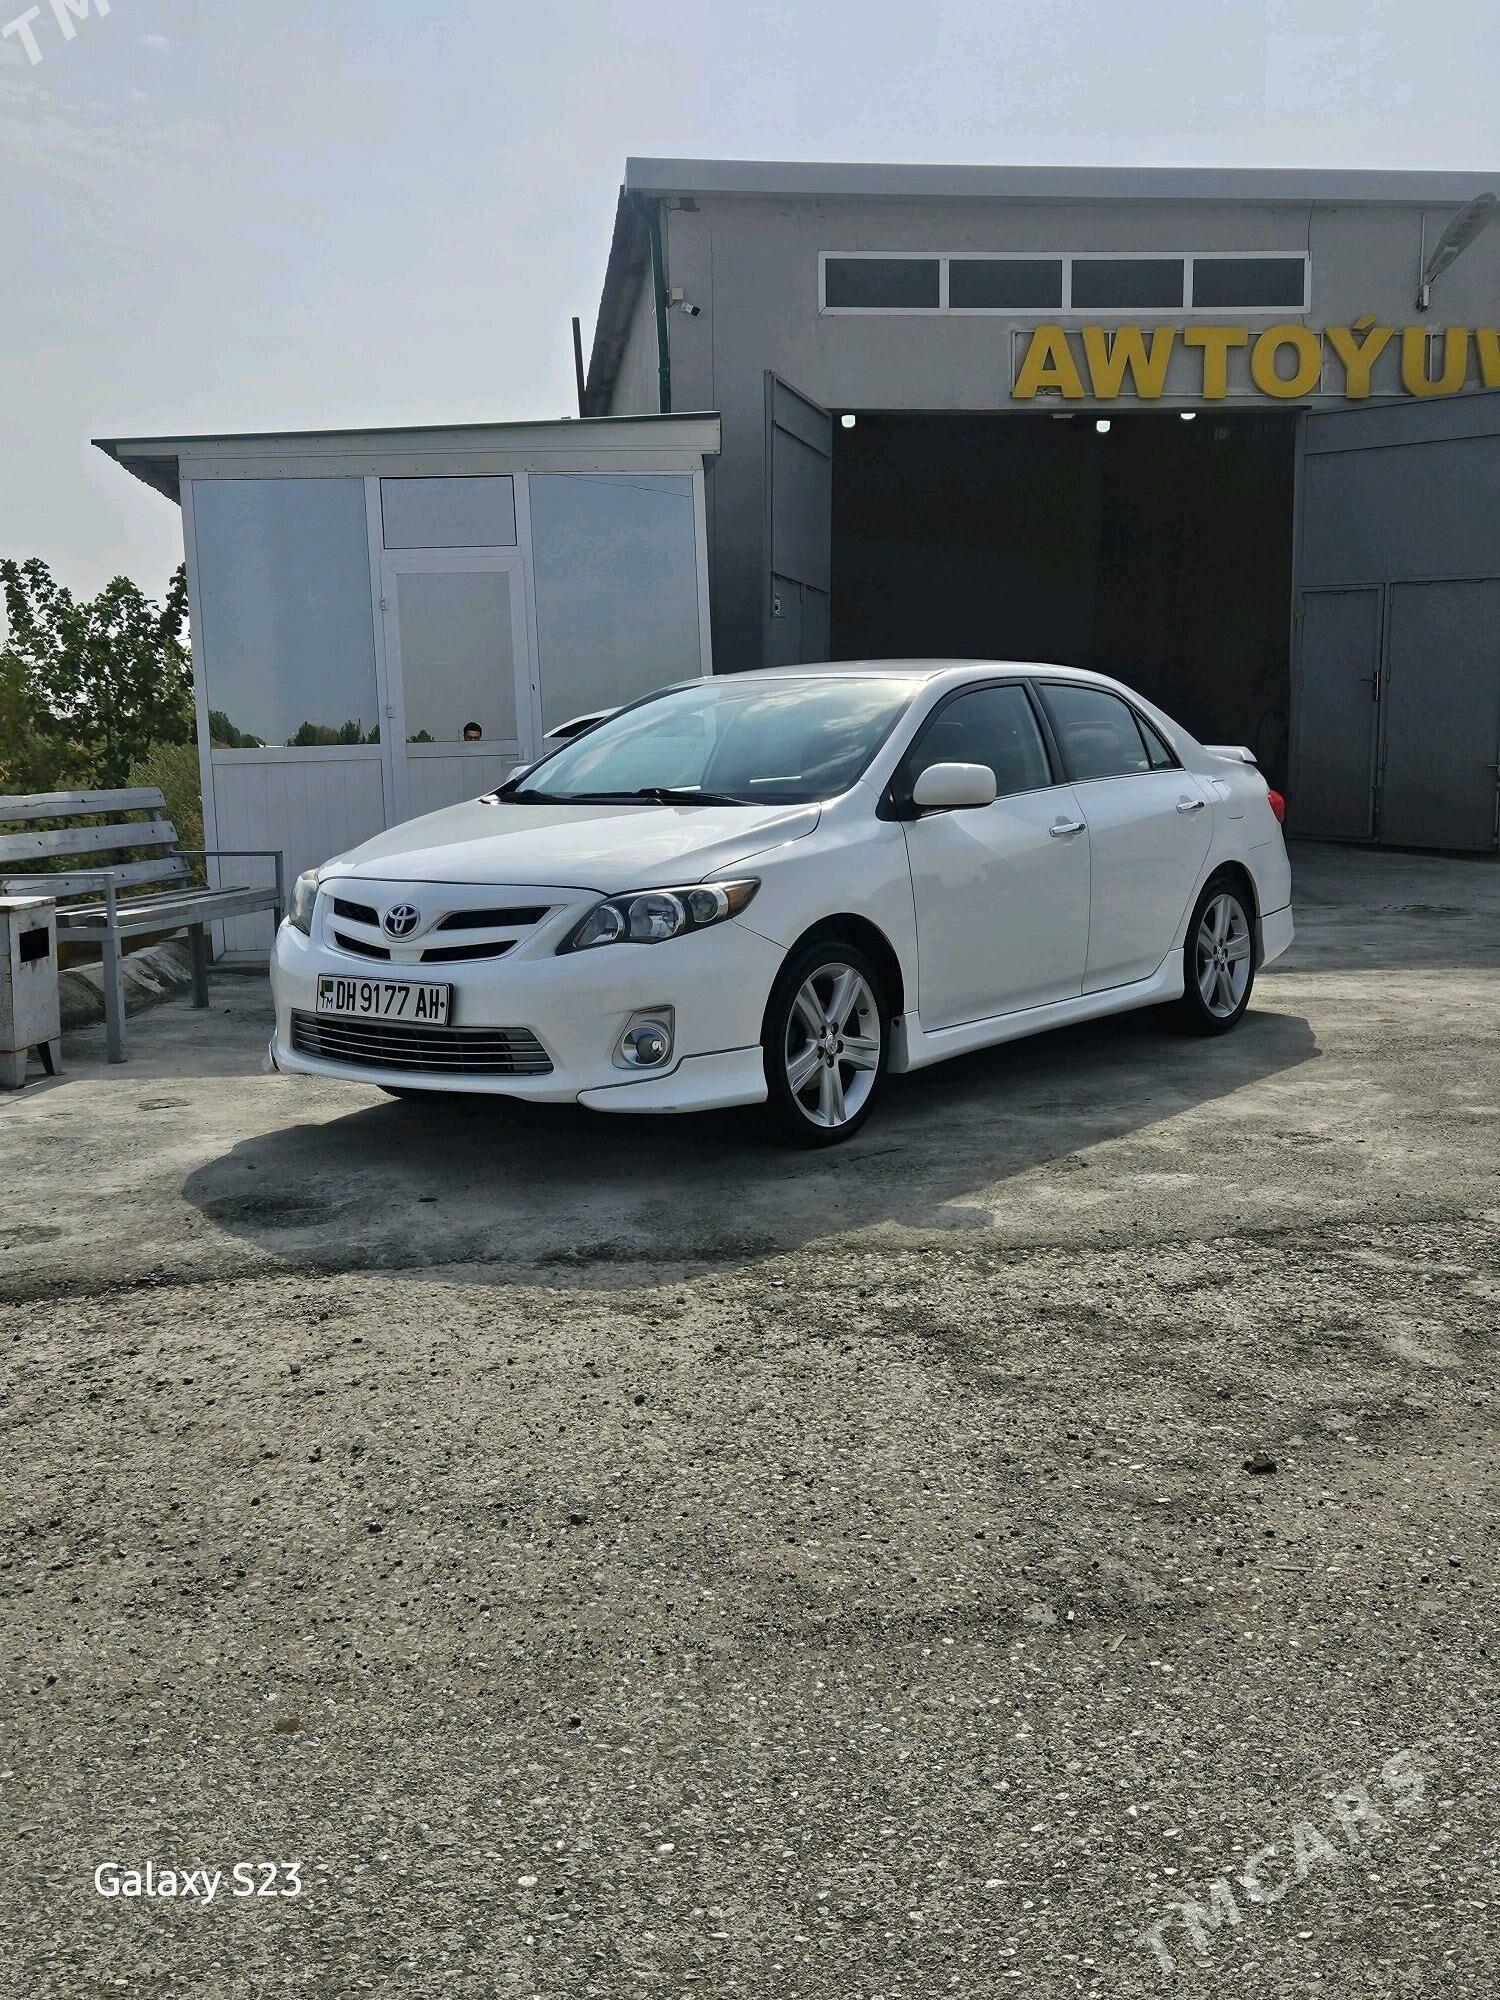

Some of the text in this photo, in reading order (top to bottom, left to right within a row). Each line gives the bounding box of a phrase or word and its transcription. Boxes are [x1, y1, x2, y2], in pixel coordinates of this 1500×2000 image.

[1012, 314, 1500, 400] AWTOÝU
[321, 995, 333, 1010] TM
[336, 980, 440, 1019] DH 9177 AH
